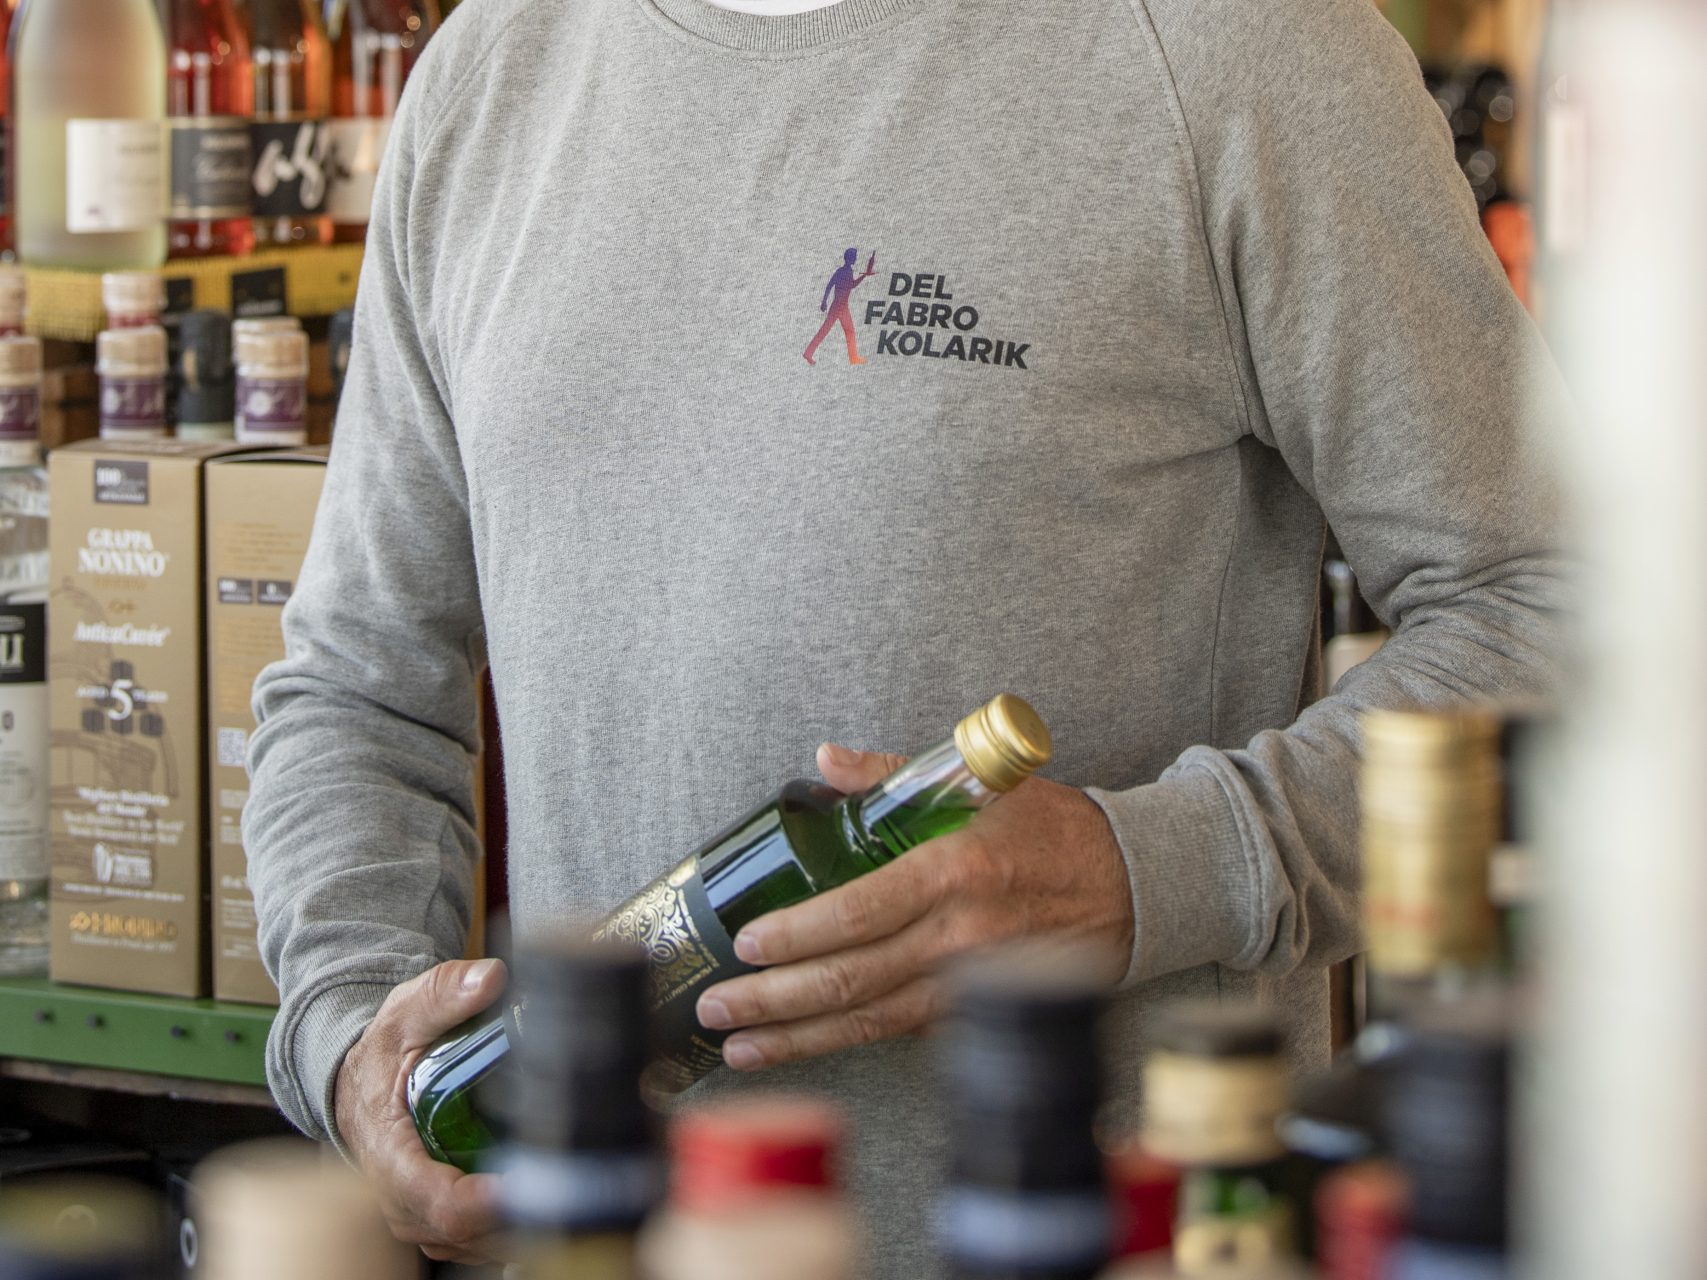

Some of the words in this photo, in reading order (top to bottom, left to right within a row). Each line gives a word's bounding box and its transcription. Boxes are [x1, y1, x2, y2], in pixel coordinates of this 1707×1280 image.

[888, 272, 953, 300] DEL
[864, 300, 979, 331] FABRO
[877, 330, 1031, 370] KOLARIK
[87, 528, 154, 551] GRAPPA
[78, 547, 166, 578] NONINO
[107, 679, 134, 721] 5
